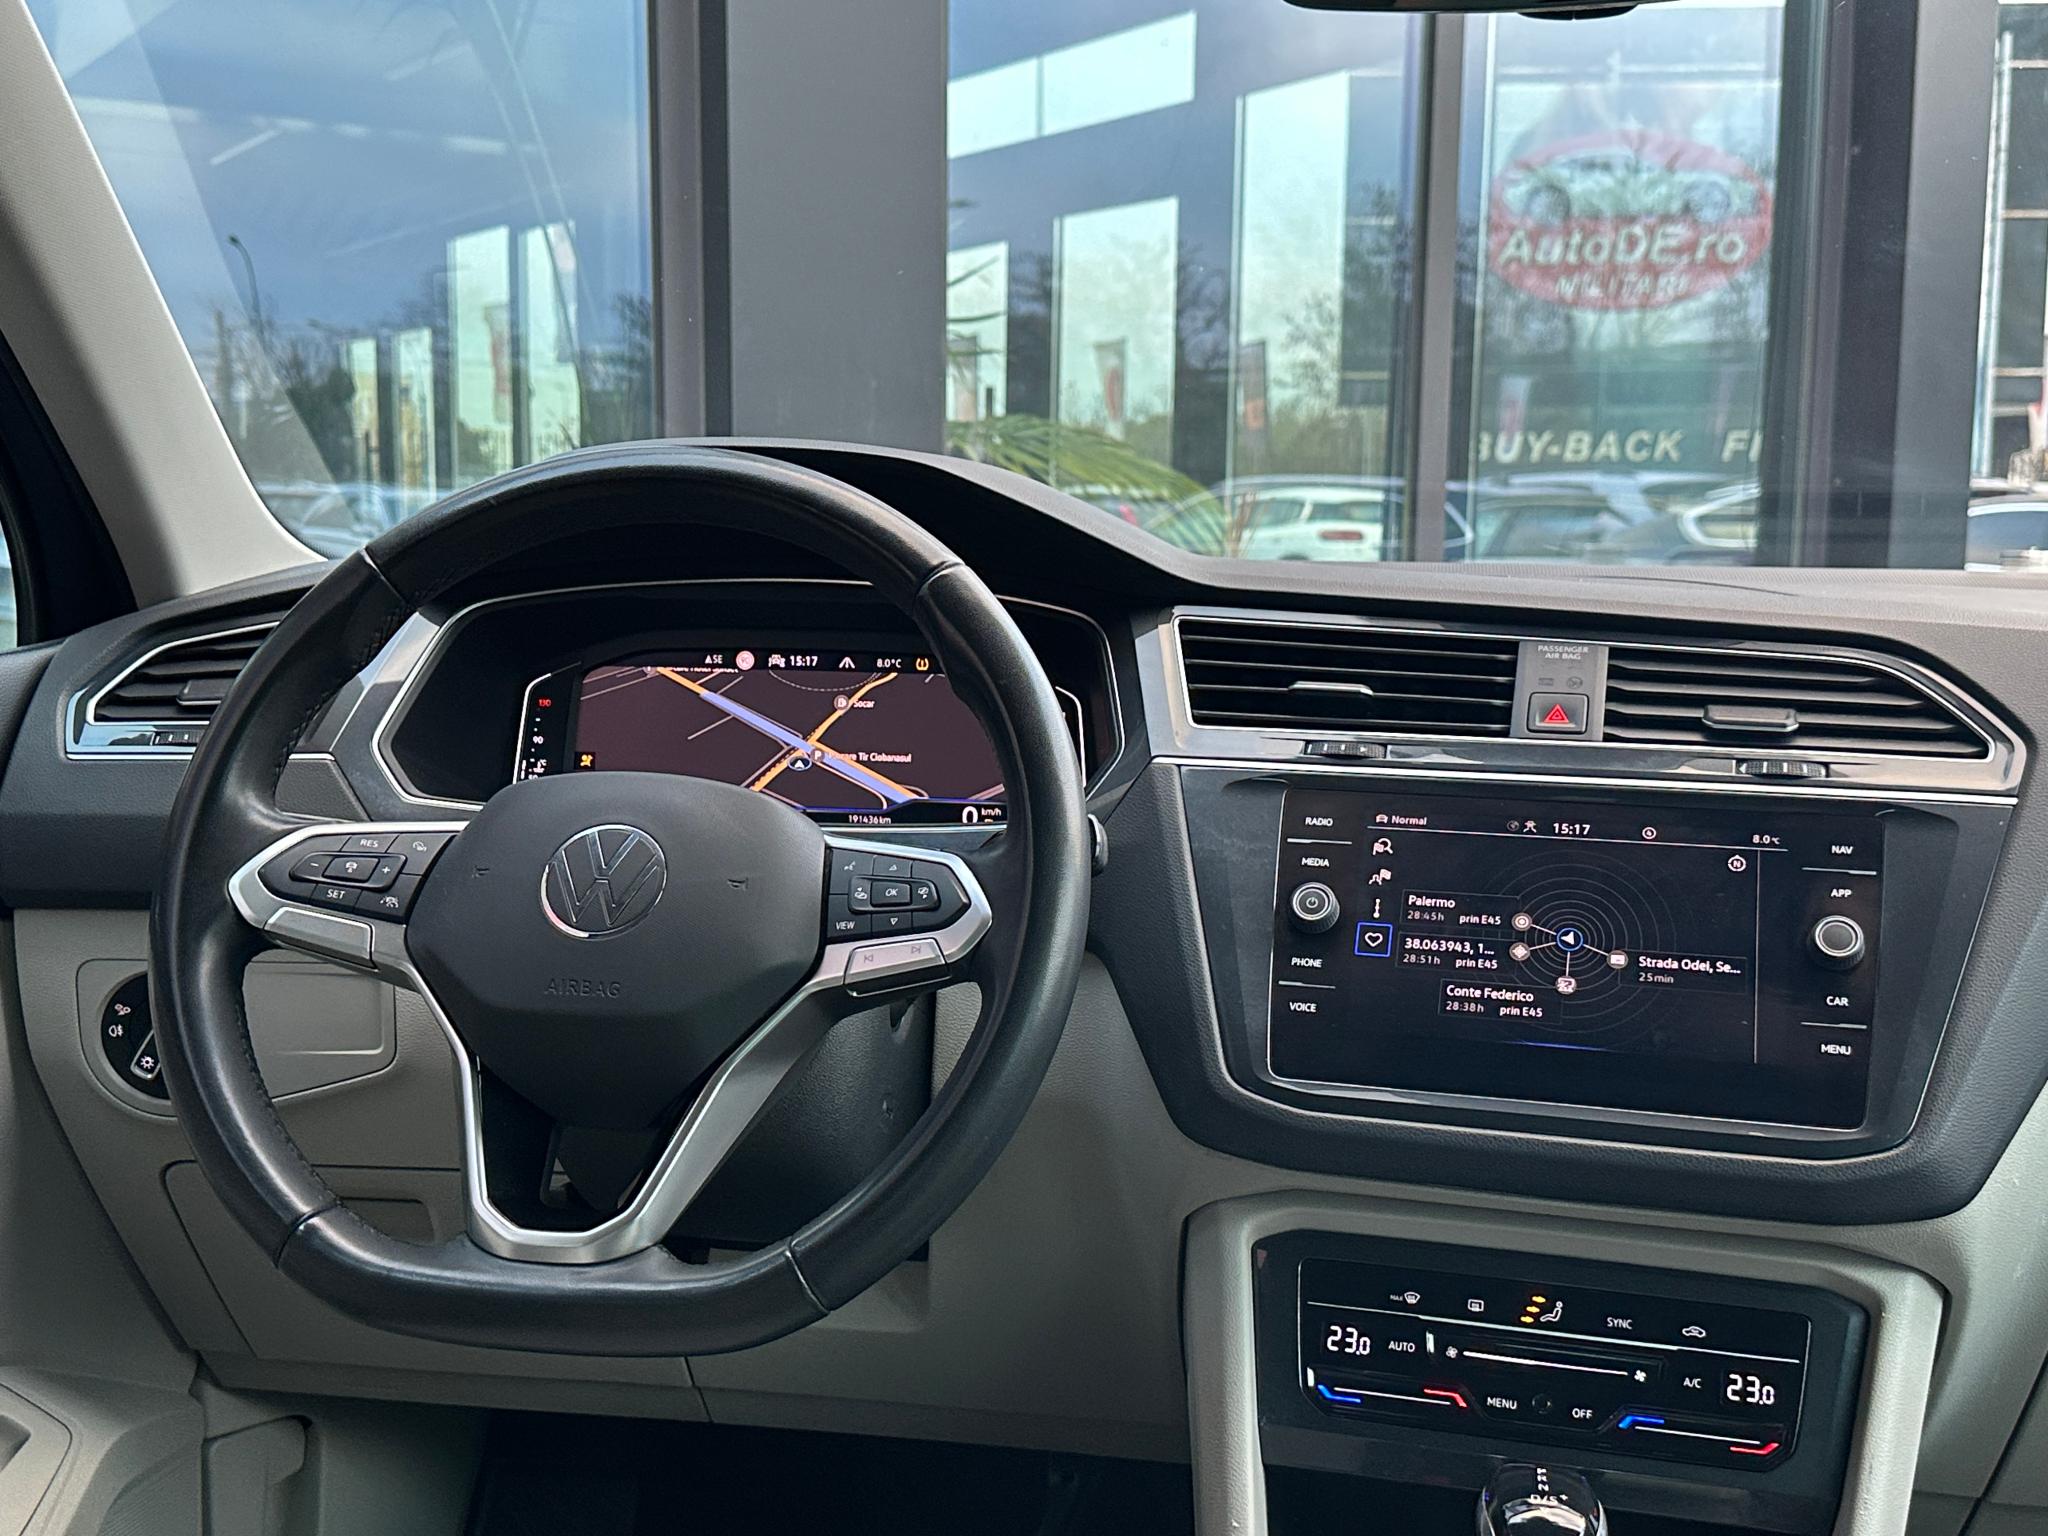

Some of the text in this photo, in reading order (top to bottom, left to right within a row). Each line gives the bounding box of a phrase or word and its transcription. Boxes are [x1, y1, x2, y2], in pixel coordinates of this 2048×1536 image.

[1537, 645, 1589, 653] PASSENGER
[790, 655, 818, 667] 15:17
[853, 700, 875, 708] Socar
[532, 736, 544, 744] 90
[961, 805, 1002, 824] 0 km/h
[1391, 815, 1427, 826] Normal
[1305, 816, 1334, 827] RADIO
[1552, 822, 1591, 836] 15:17
[360, 838, 379, 848] RES
[1831, 845, 1853, 854] NAV
[1301, 857, 1330, 867] MEDIA
[326, 888, 346, 899] SET
[885, 888, 899, 897] OK
[1830, 888, 1852, 898] APP
[1408, 894, 1456, 909] Palermo
[835, 921, 856, 930] VIEW
[1459, 914, 1480, 925] prin
[1481, 915, 1501, 925] E45
[1404, 937, 1474, 955] 38.063943,
[1291, 957, 1323, 968] PHONE
[1455, 957, 1476, 969] prin
[1477, 959, 1498, 969] E45
[1638, 956, 1679, 970] Strada
[1715, 961, 1742, 973] Se...
[544, 976, 622, 999] AIRBAG
[1446, 985, 1535, 1002] Conte Federico
[1289, 1001, 1318, 1013] VOICE
[1826, 996, 1849, 1007] CAR
[1499, 1005, 1521, 1017] prin
[1522, 1006, 1543, 1017] E45
[1820, 1044, 1852, 1055] MENU
[1606, 1316, 1633, 1330] SYNC
[1326, 1325, 1371, 1356] 23.0
[1388, 1340, 1416, 1353] AUTO
[1682, 1377, 1702, 1389] A/C
[1726, 1373, 1775, 1405] 23.0
[1486, 1396, 1518, 1410] MENU
[1571, 1407, 1593, 1419] OFF
